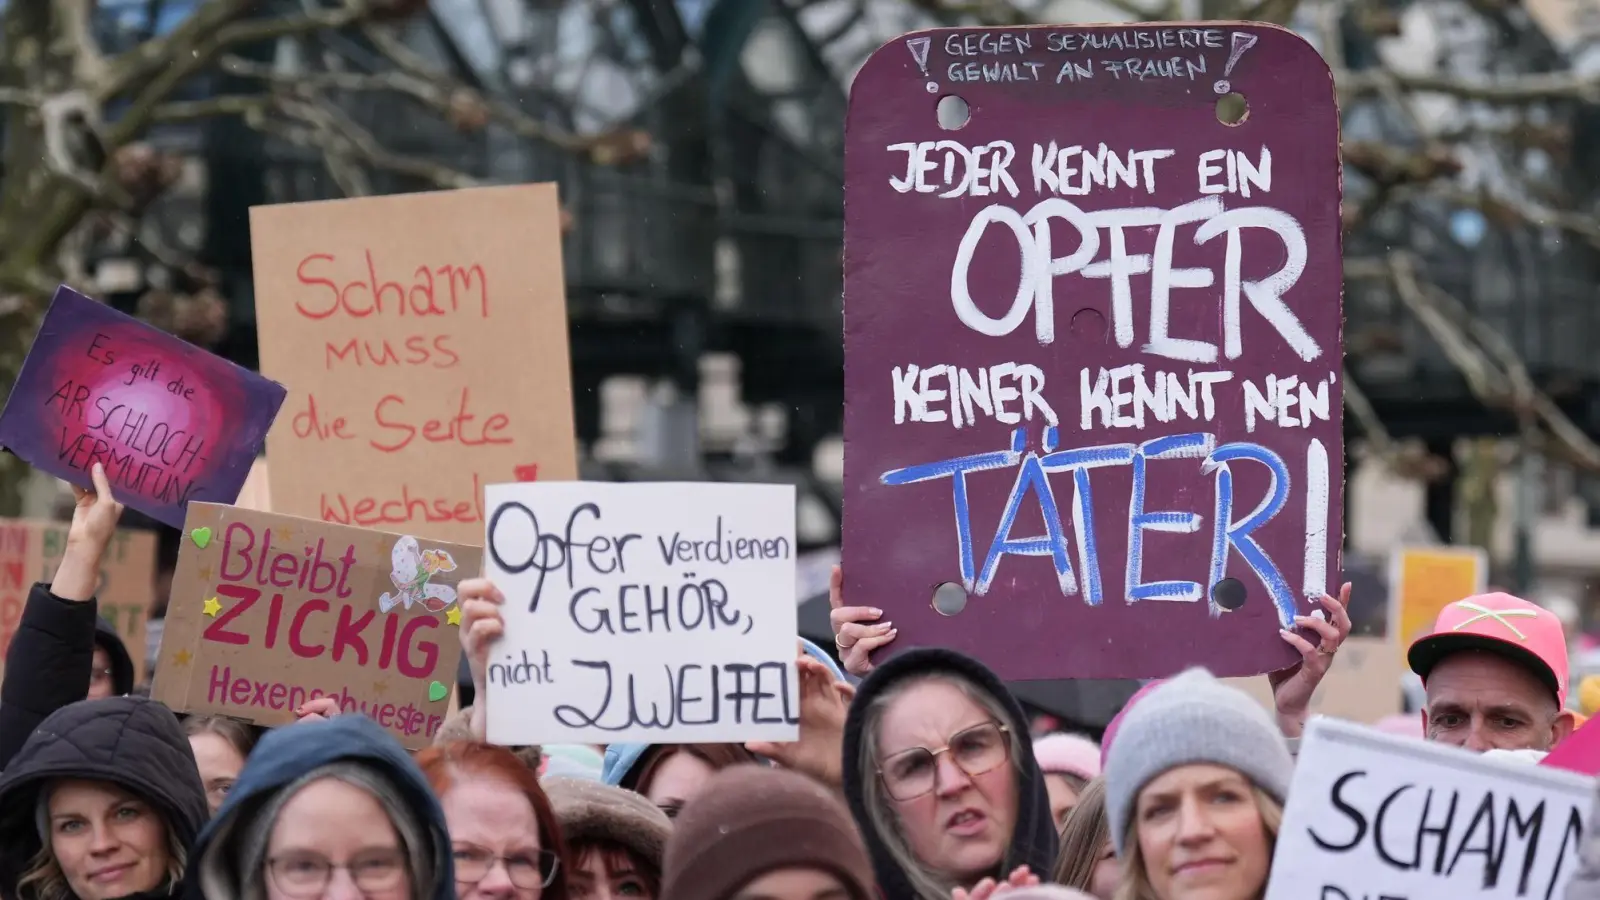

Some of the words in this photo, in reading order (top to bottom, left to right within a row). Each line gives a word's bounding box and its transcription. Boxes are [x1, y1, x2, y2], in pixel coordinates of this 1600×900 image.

[945, 33, 1032, 56] GEGEN
[1047, 28, 1225, 52] SEXUALISIERTE
[947, 60, 1045, 83] GEWALT
[1056, 58, 1095, 84] AN
[1101, 54, 1207, 82] FRAUEN
[887, 139, 1020, 199] JEDER
[1032, 139, 1176, 197] KENNT
[1199, 144, 1272, 198] EIN
[294, 248, 490, 320] Scham
[950, 194, 1323, 364] OPFER
[86, 333, 115, 366] Es
[123, 359, 160, 386] gilt
[166, 375, 195, 401] die
[891, 362, 1060, 429] KEINER
[1079, 362, 1235, 430] KENNT
[292, 392, 356, 441] die
[369, 386, 514, 453] Seite
[320, 472, 485, 526] wechsel
[219, 521, 357, 599] Bleibt
[487, 501, 643, 614] Opfer
[203, 583, 441, 680] ZICKIG
[569, 572, 754, 635] GEHÖR,
[488, 650, 554, 688] nicht
[553, 660, 800, 732] ZWEIFEL
[1306, 769, 1546, 898] SCHAM
